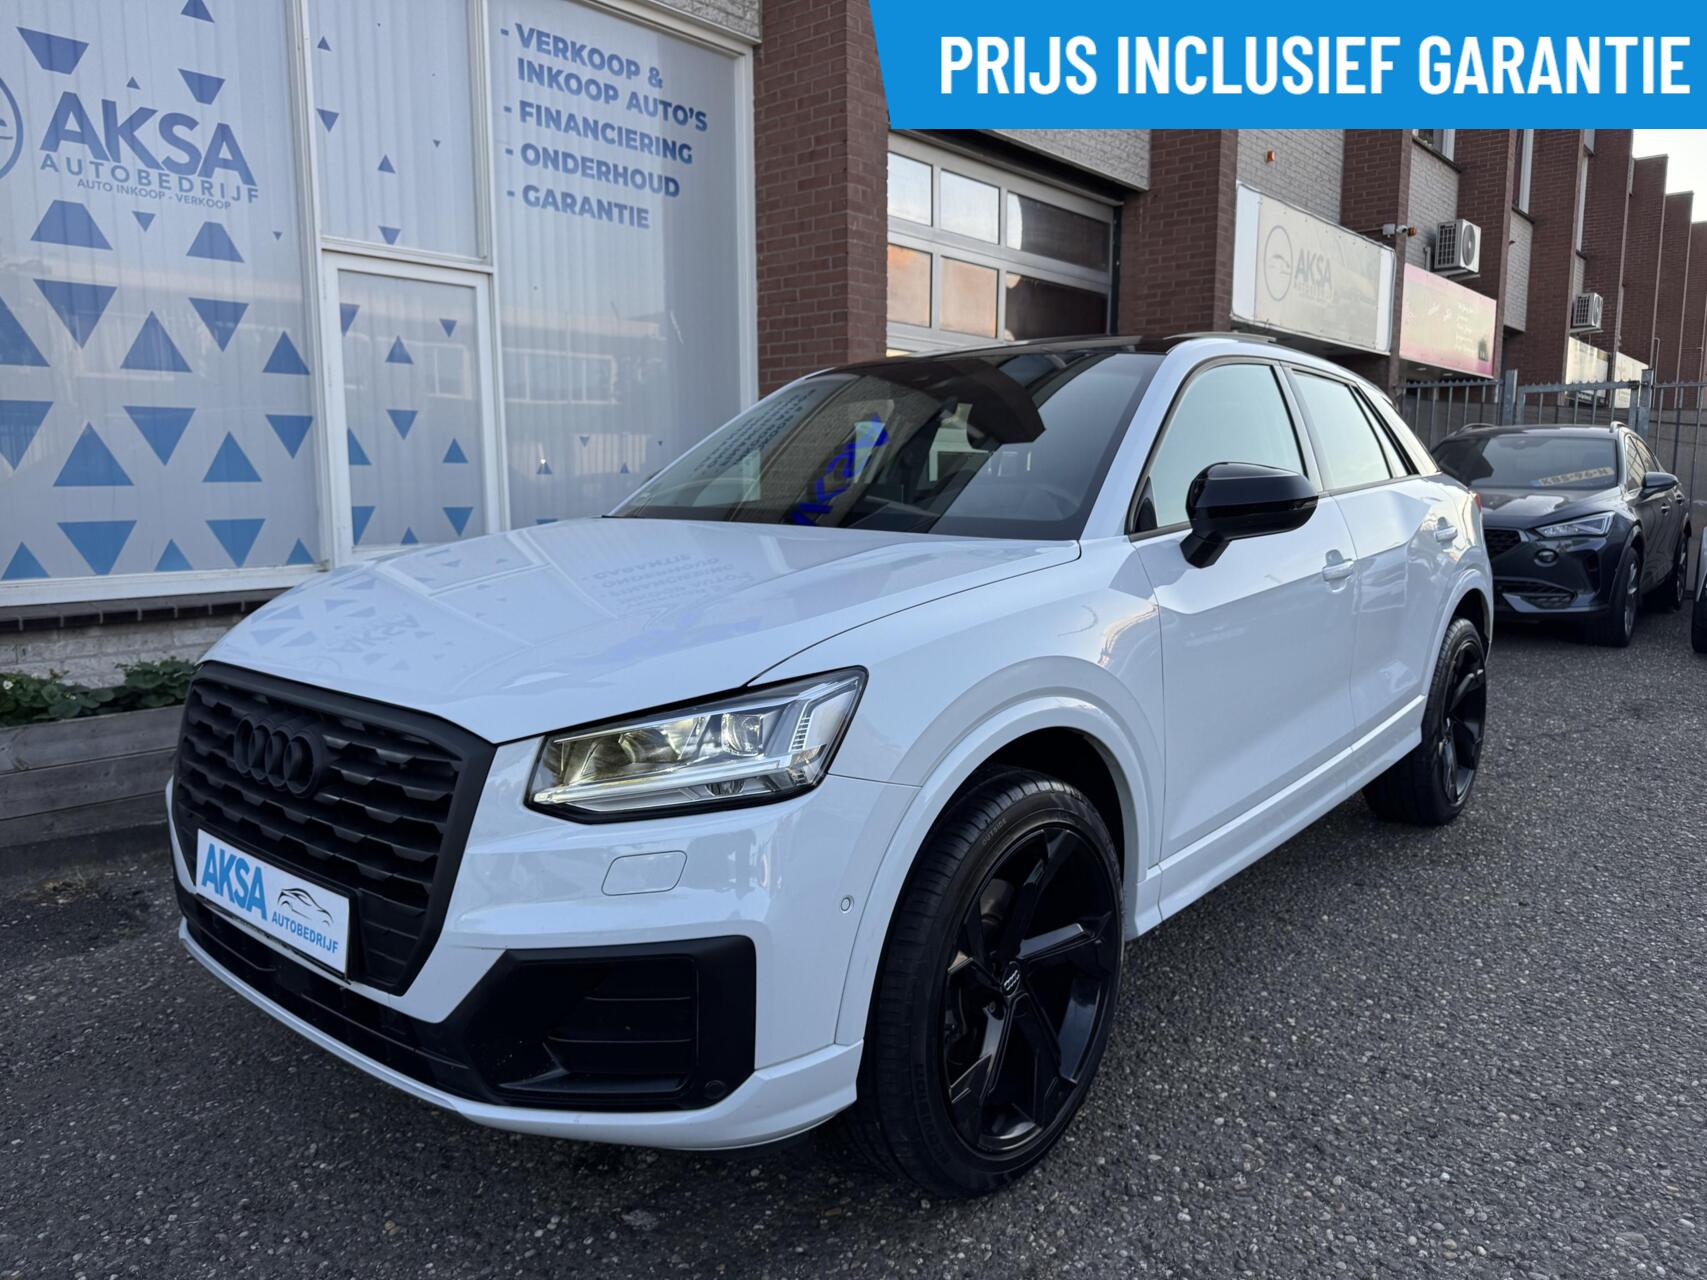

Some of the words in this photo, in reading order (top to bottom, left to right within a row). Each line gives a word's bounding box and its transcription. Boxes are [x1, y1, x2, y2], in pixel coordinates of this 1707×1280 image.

[515, 22, 641, 80] VERKOOP
[648, 67, 663, 89] &
[517, 57, 619, 104] INKOOP
[626, 91, 708, 132] AUTO'S
[39, 90, 257, 187] AKSA
[519, 99, 693, 164] FINANCIERING
[39, 153, 259, 203] AUTOBEDRIJF
[77, 177, 113, 192] AUTO
[116, 184, 166, 201] INKOOP
[175, 193, 232, 210] VERKOOP
[521, 142, 681, 198] ONDERHOUD
[522, 184, 650, 229] GARANTIE
[1294, 247, 1333, 291] AKSA
[201, 842, 268, 922] AKSA
[271, 910, 339, 954] AUTOBEDRIJF
